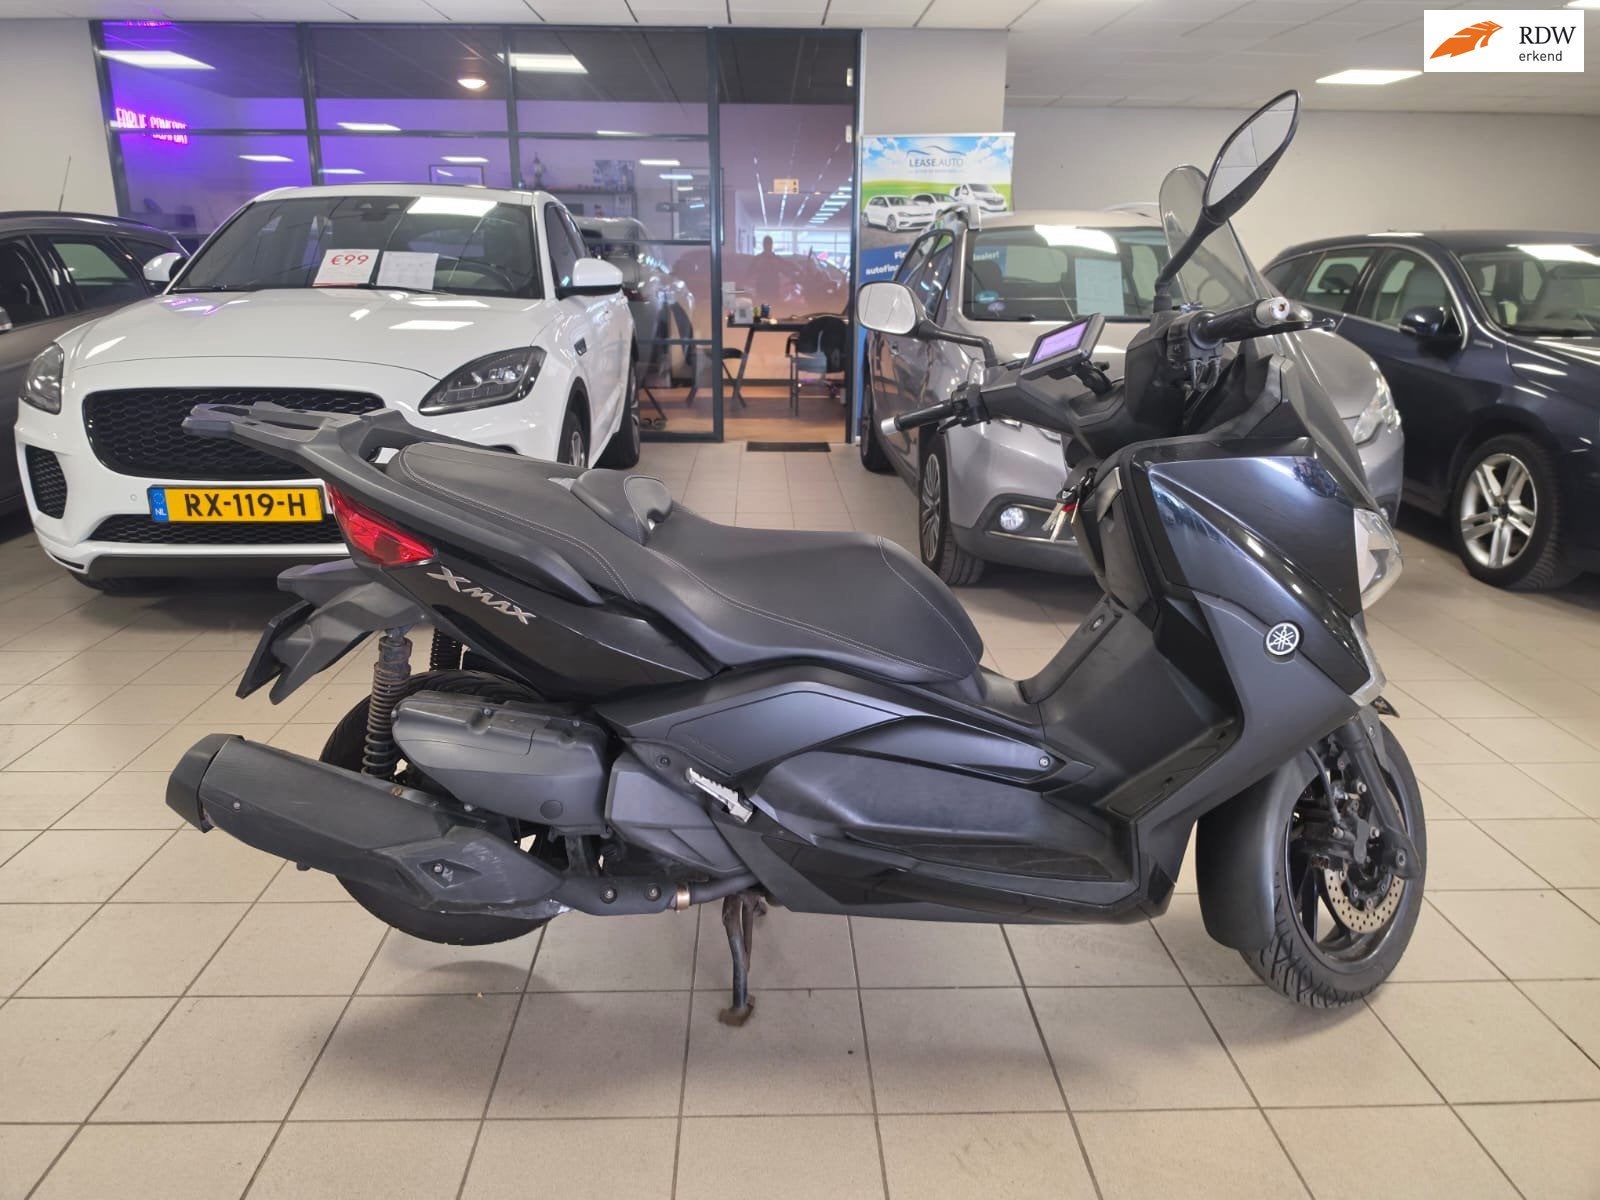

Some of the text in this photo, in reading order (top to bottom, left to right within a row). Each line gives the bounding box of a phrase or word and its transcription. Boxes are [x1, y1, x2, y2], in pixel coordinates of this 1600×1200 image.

[331, 254, 369, 266] €99
[184, 492, 306, 517] RX-119-H
[154, 508, 167, 517] NL
